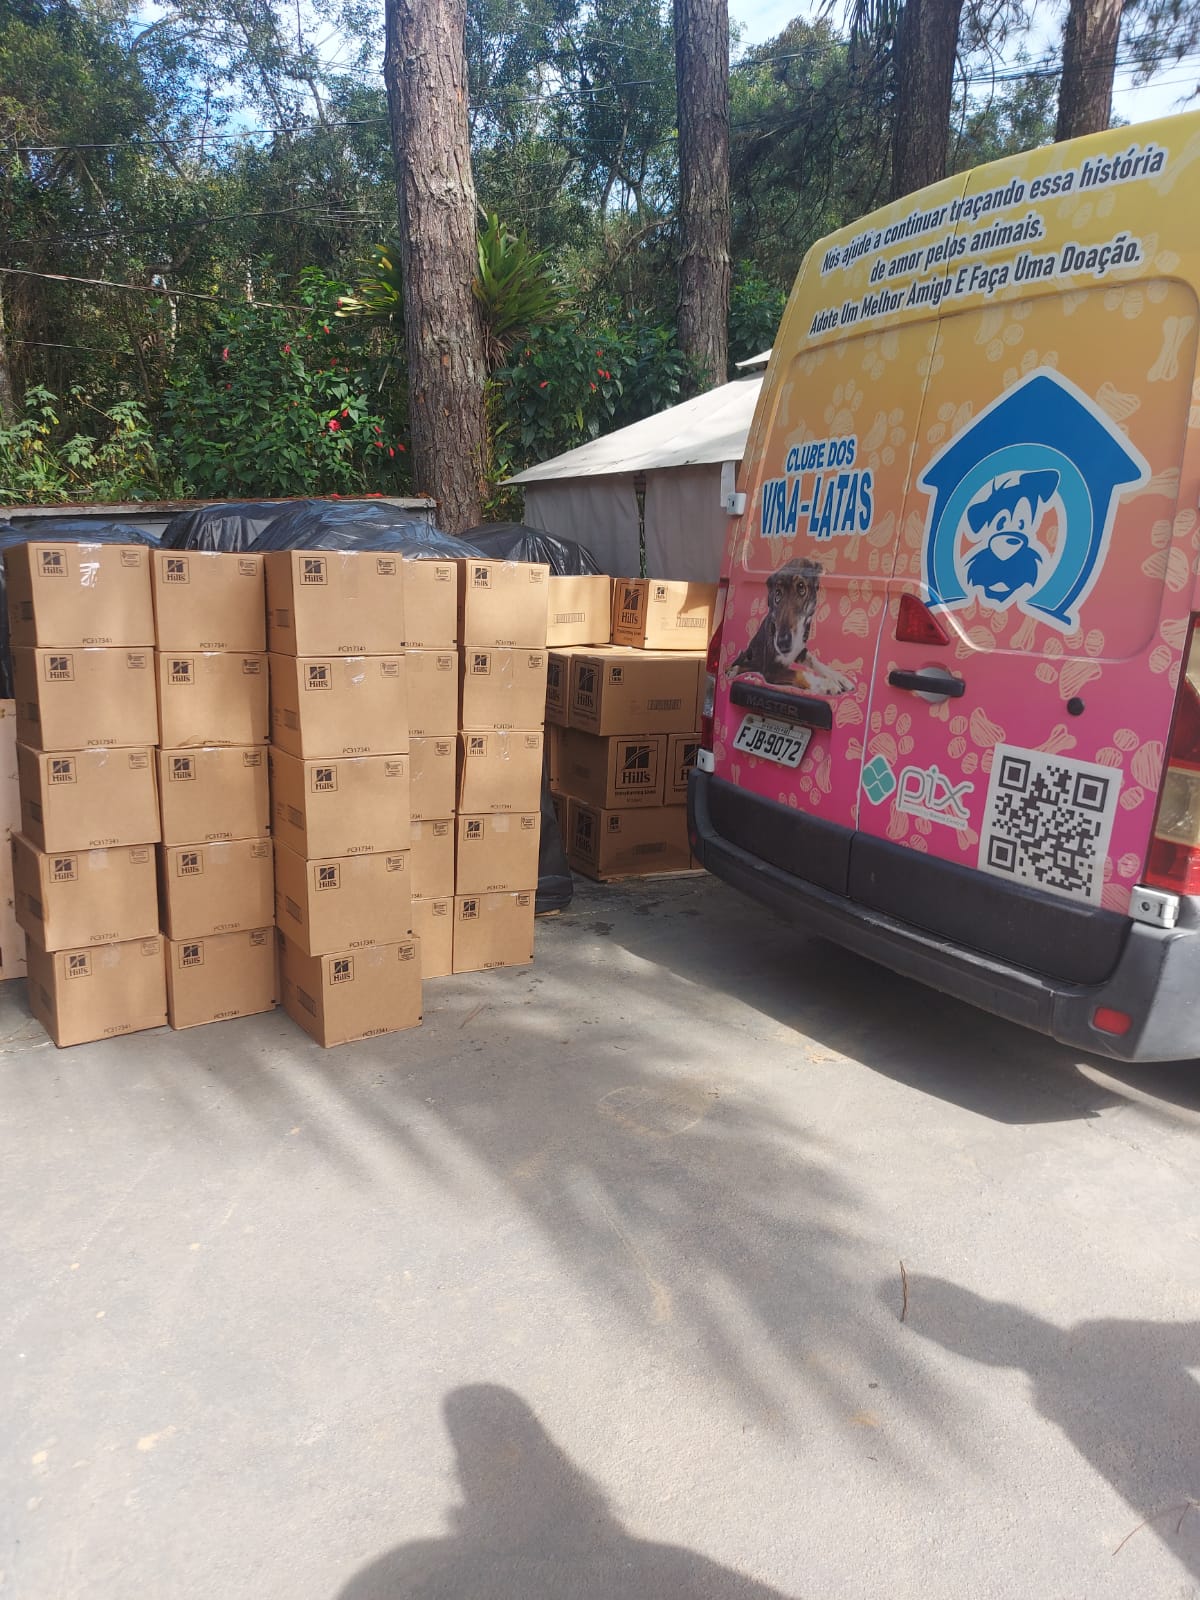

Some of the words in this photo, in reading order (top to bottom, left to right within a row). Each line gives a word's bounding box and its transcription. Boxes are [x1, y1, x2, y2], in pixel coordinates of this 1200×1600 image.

[823, 251, 840, 272] Nós
[841, 234, 872, 266] ajude
[873, 233, 882, 249] a
[884, 205, 947, 245] continuar
[949, 180, 1026, 229] traçando
[1030, 173, 1073, 200] essa
[1079, 147, 1164, 189] história
[870, 264, 886, 283] de
[888, 253, 921, 278] amor
[925, 236, 966, 265] pelos
[971, 214, 1044, 251] animais.
[809, 306, 839, 336] Adote
[840, 299, 860, 324] Um
[860, 289, 905, 316] Melhor
[906, 274, 953, 308] Amigo
[955, 272, 968, 294] E
[969, 261, 1009, 295] Faça
[1013, 251, 1055, 282] Uma
[1060, 234, 1141, 271] Doação.
[786, 443, 826, 471] CLUBE
[828, 438, 856, 466] DOS
[43, 566, 64, 575] Hill's
[167, 573, 186, 582] Hill's
[304, 574, 324, 583] Hill's
[621, 611, 639, 625] Hill's
[50, 671, 70, 680] Hill's
[172, 674, 191, 683] Hill's
[309, 679, 328, 689] Hill's
[746, 694, 799, 716] MASTER
[52, 773, 73, 783] Hill's
[173, 771, 192, 780] Hill's
[622, 771, 651, 784] Hill's
[315, 781, 334, 790] Hill's
[898, 767, 973, 815] pix
[181, 865, 200, 874] Hill's
[54, 871, 75, 881] Hill's
[319, 879, 337, 889] Hill's
[183, 956, 201, 966] Hill's
[69, 967, 88, 977] Hill's
[333, 972, 351, 982] Hill's
